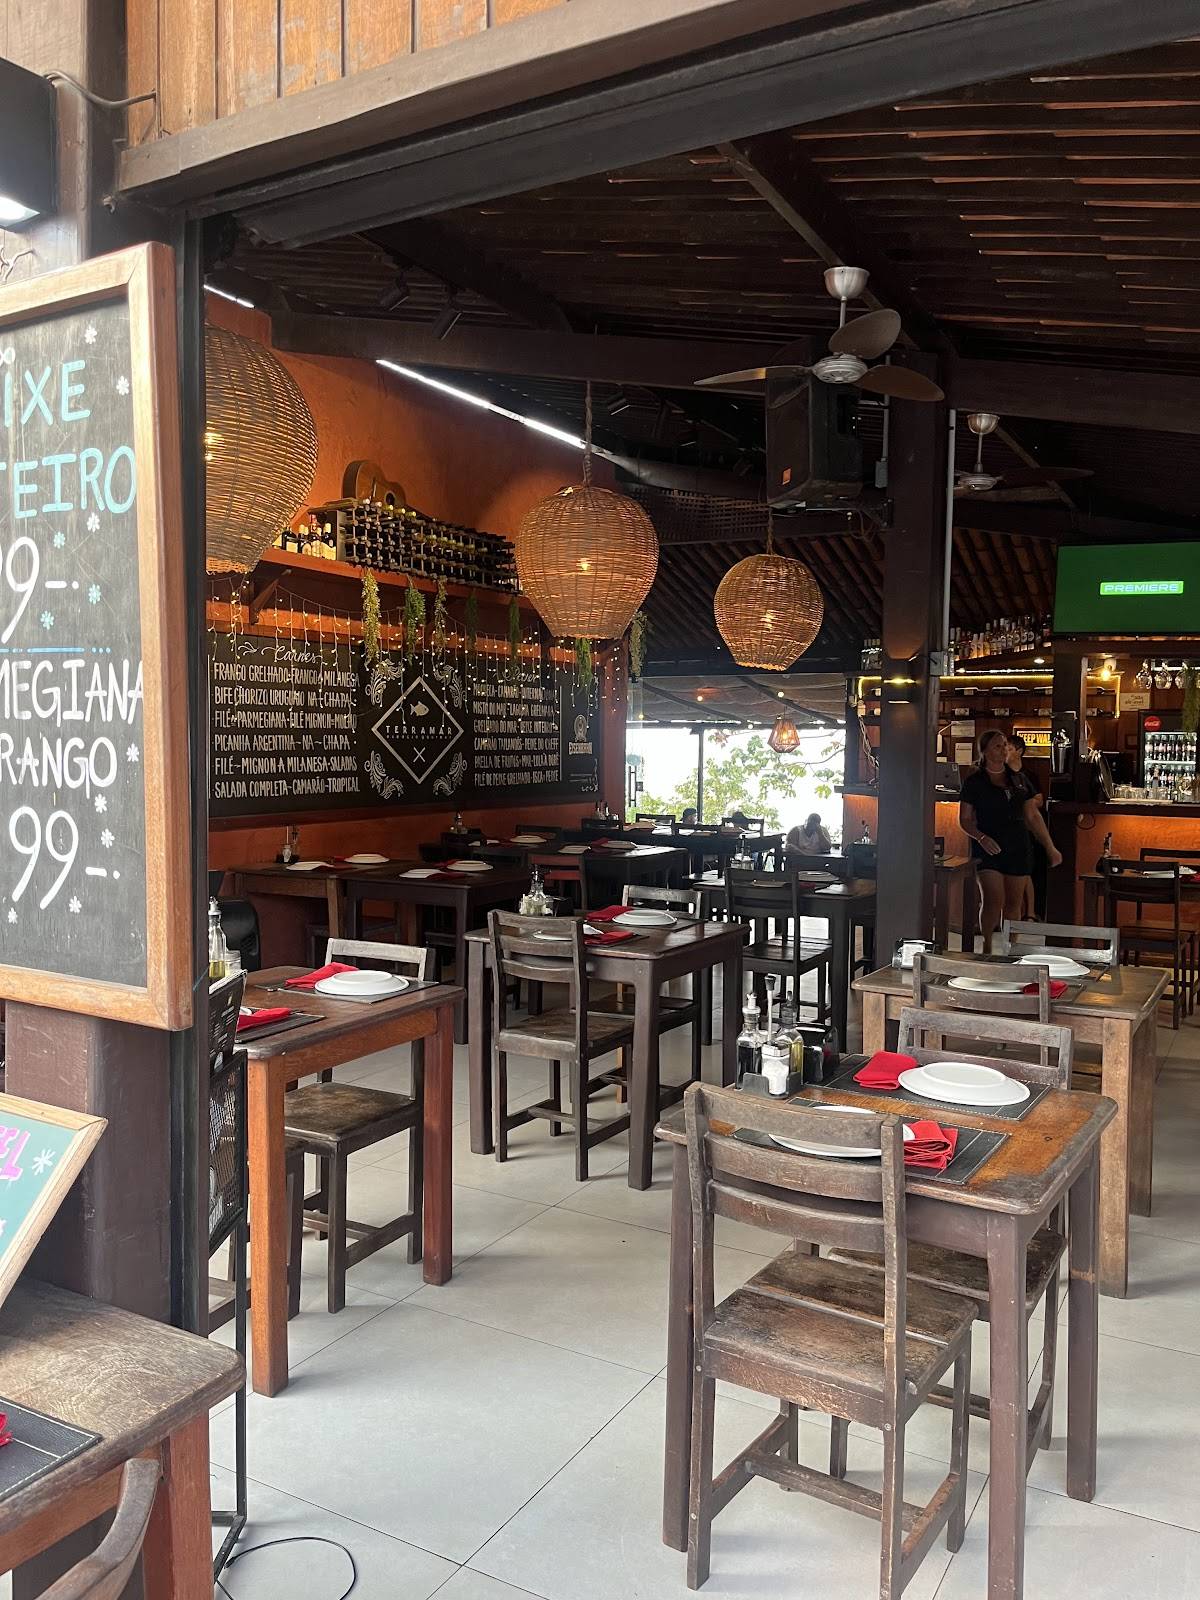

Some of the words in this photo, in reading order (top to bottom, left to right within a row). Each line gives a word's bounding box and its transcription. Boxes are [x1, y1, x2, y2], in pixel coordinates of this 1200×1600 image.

[0, 445, 137, 519] EIRO
[1103, 583, 1179, 593] PREMIERE
[213, 662, 246, 682] FRANGO
[249, 664, 288, 683] GRELHADO
[324, 670, 360, 688] MILANESA
[214, 685, 232, 705] BIFE
[234, 686, 268, 706] CHORIZO
[307, 690, 318, 707] NA
[323, 691, 350, 709] CHAPA
[237, 710, 287, 729] PARMEGIANA
[305, 712, 331, 729] MIGNON
[385, 725, 452, 735] TERRAMAR
[214, 734, 250, 751] PICANHA
[252, 734, 296, 752] ARGENTINA
[302, 734, 314, 751] NA
[323, 734, 351, 751] CHAPA
[214, 754, 235, 775] FILÉ
[241, 757, 277, 775] MIGNON
[286, 756, 329, 773] MILANESA
[214, 780, 248, 799] SALADA
[249, 779, 289, 798] COMPLETA
[326, 776, 361, 793] TROPICAL
